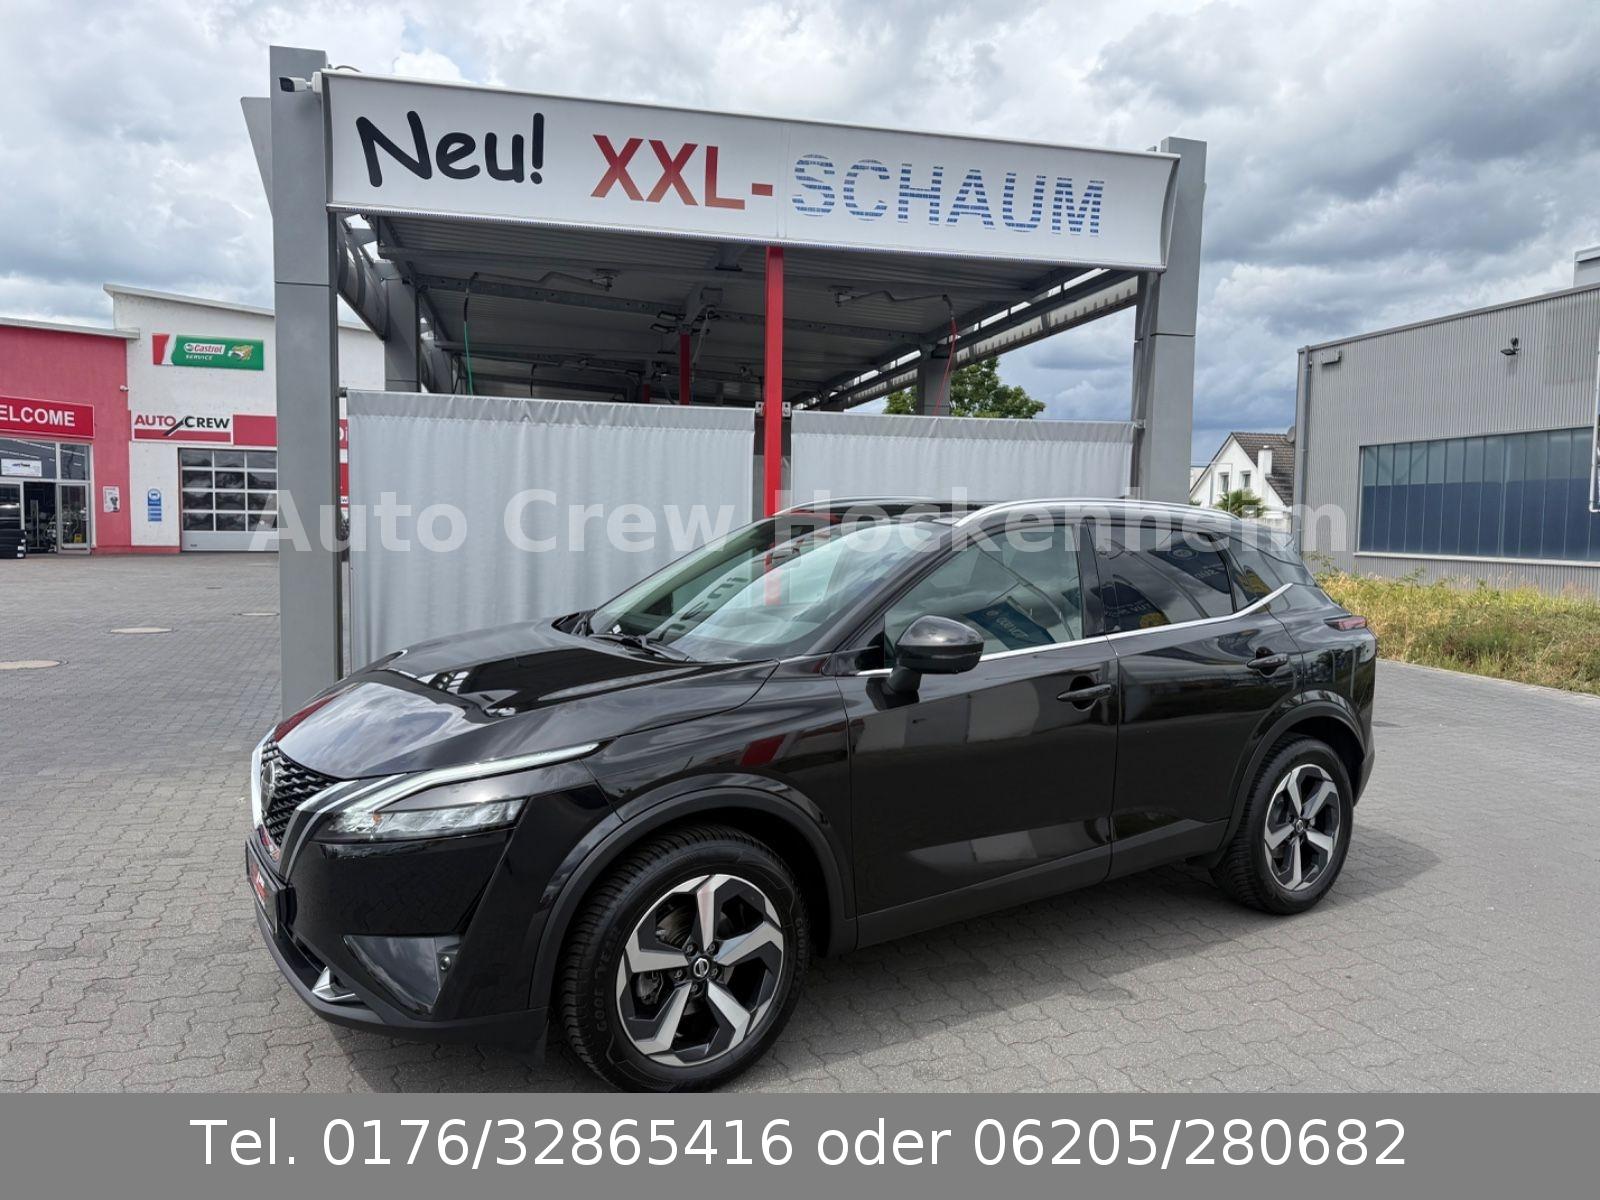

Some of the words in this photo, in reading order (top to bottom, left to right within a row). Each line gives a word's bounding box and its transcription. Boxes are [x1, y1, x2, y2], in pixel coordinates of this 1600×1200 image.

[355, 110, 545, 188] Neu!
[791, 153, 1105, 237] SCHAUM
[194, 343, 224, 354] Castrol
[134, 414, 177, 427] AUTO
[184, 415, 230, 429] CREW
